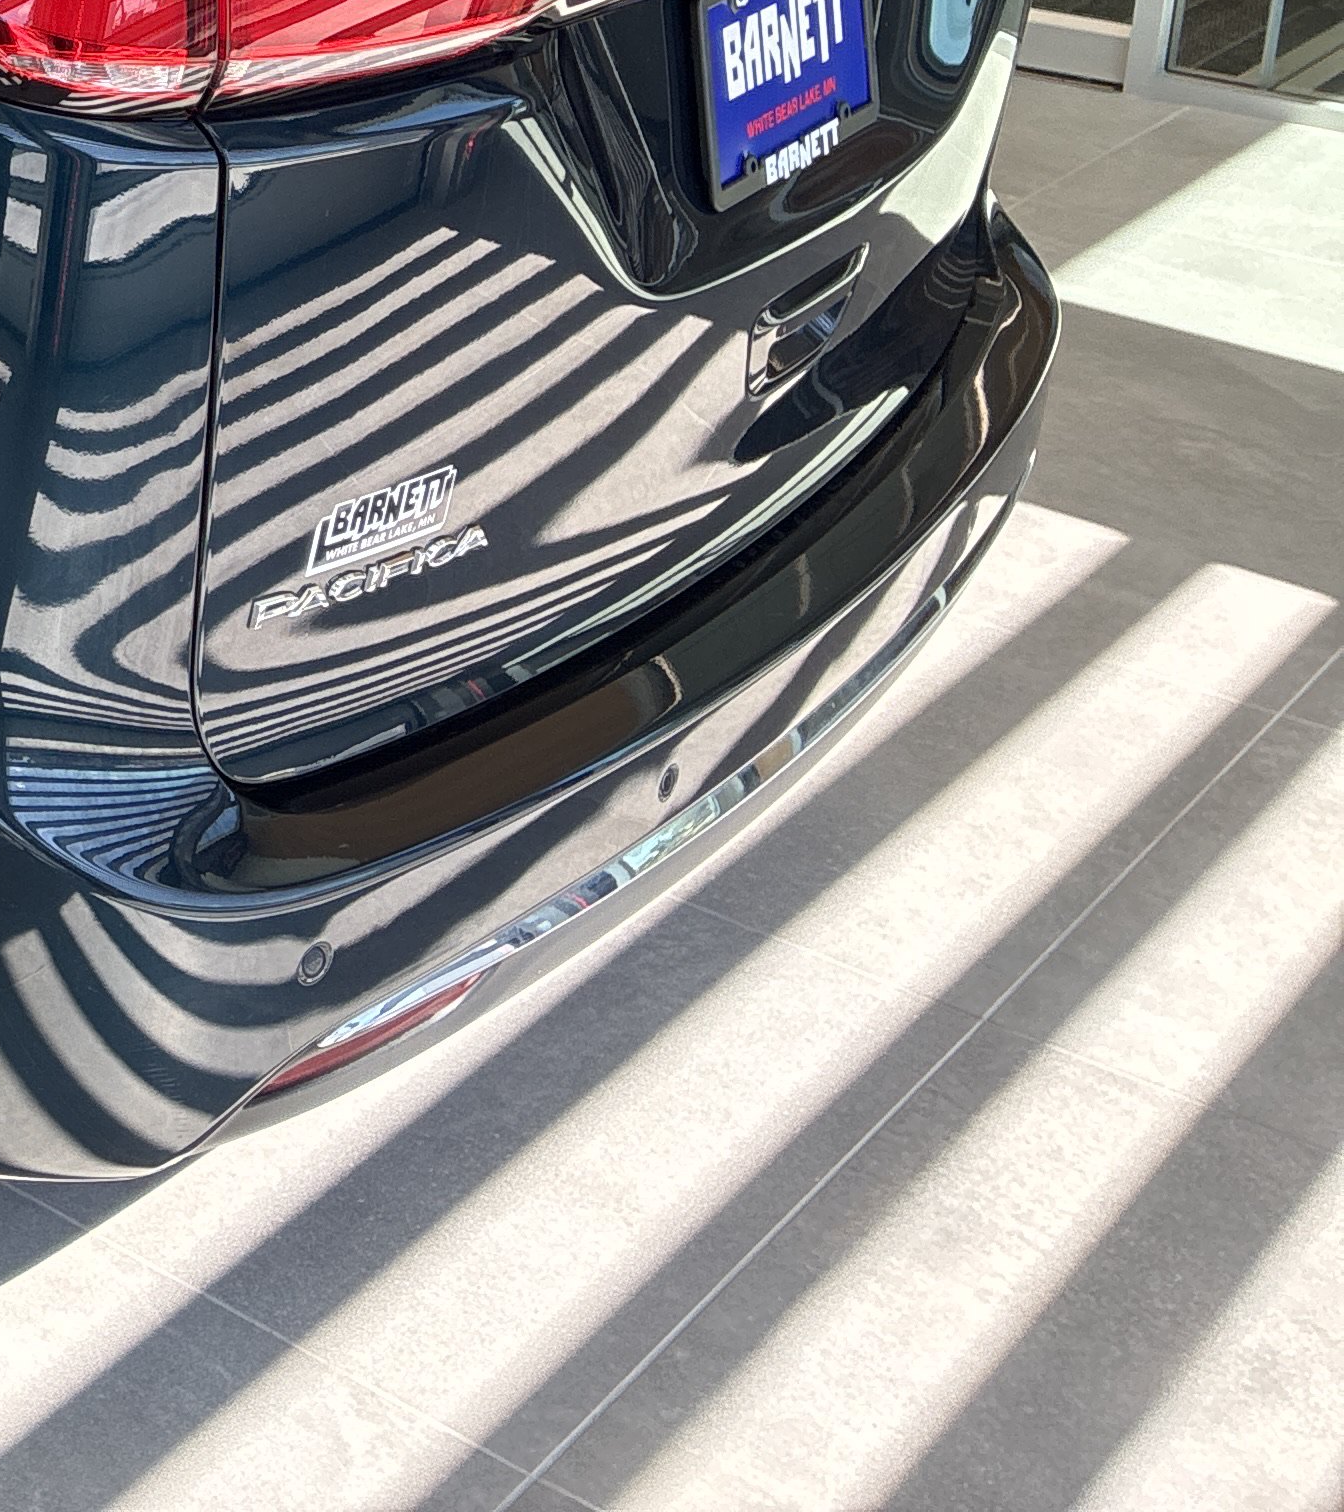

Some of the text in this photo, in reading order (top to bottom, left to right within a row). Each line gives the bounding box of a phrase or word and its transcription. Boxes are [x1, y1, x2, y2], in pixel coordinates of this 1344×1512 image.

[746, 110, 775, 138] WHITE
[775, 97, 799, 125] BEAR
[764, 117, 840, 185] BARNETT
[325, 513, 436, 561] WHITE BEAR LAKE, MN
[330, 468, 452, 538] BARNETT
[246, 524, 489, 630] PACIFICA
